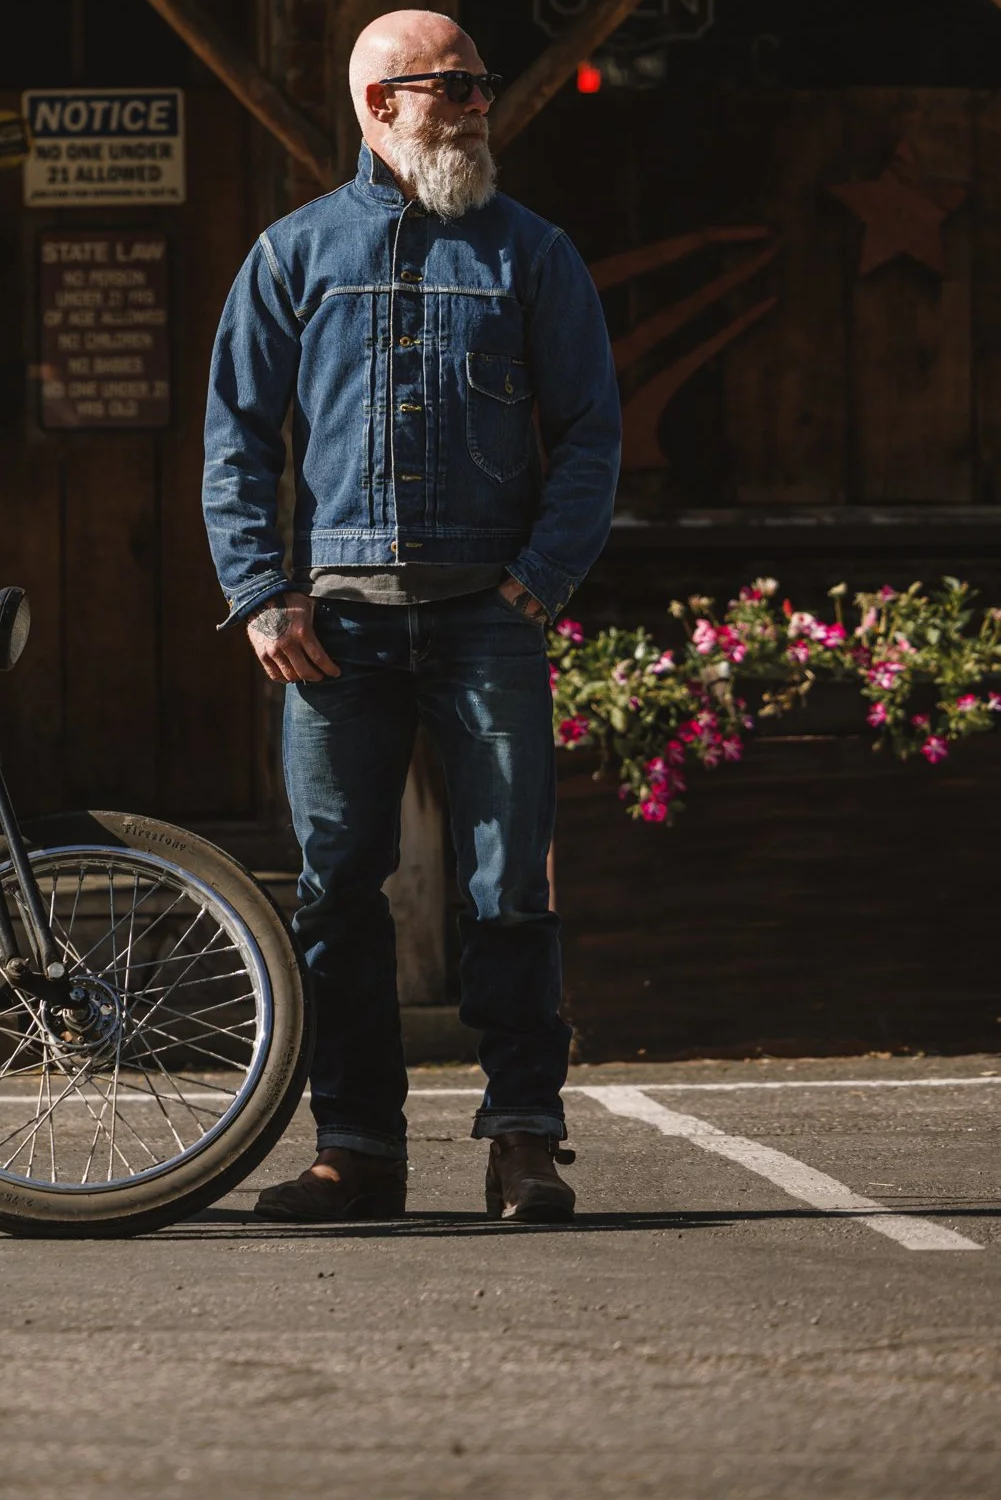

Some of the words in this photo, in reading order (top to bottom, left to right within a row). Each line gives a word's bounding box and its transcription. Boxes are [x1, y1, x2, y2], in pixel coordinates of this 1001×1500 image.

[33, 99, 173, 133] NOTICE
[35, 143, 62, 162] NO
[65, 143, 102, 161] ONE
[108, 142, 174, 161] UNDER
[46, 165, 69, 184] 21
[74, 165, 163, 183] ALLOWED
[42, 241, 110, 264] STATE
[115, 241, 167, 263] LAW
[121, 823, 187, 851] Firestone
